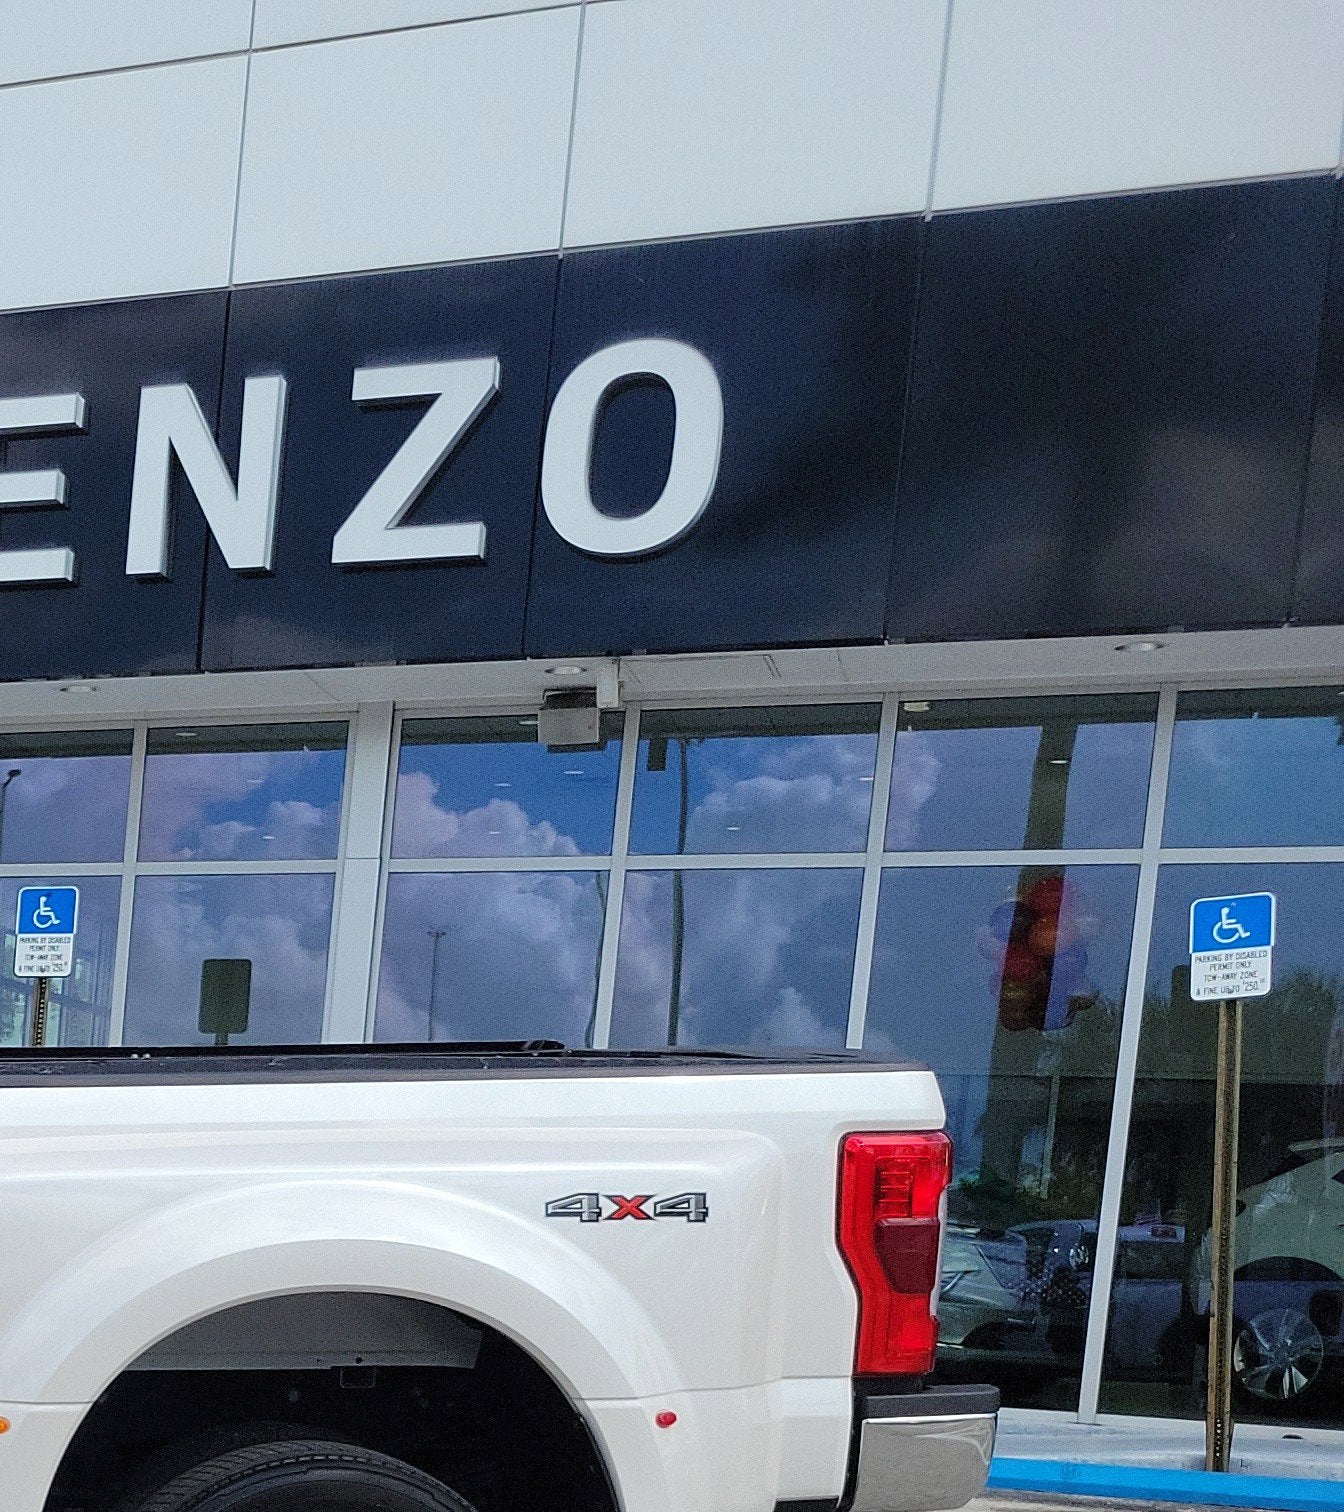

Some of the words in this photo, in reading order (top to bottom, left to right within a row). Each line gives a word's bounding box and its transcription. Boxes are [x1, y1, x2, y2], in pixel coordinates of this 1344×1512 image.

[1195, 953, 1222, 964] PARKING
[1225, 953, 1233, 961] BY
[1235, 950, 1268, 960] DISABLED
[1210, 962, 1232, 971] PERMIT
[1236, 961, 1252, 969] ONLY
[1240, 970, 1258, 979] ZONE
[1203, 986, 1218, 995] FINE
